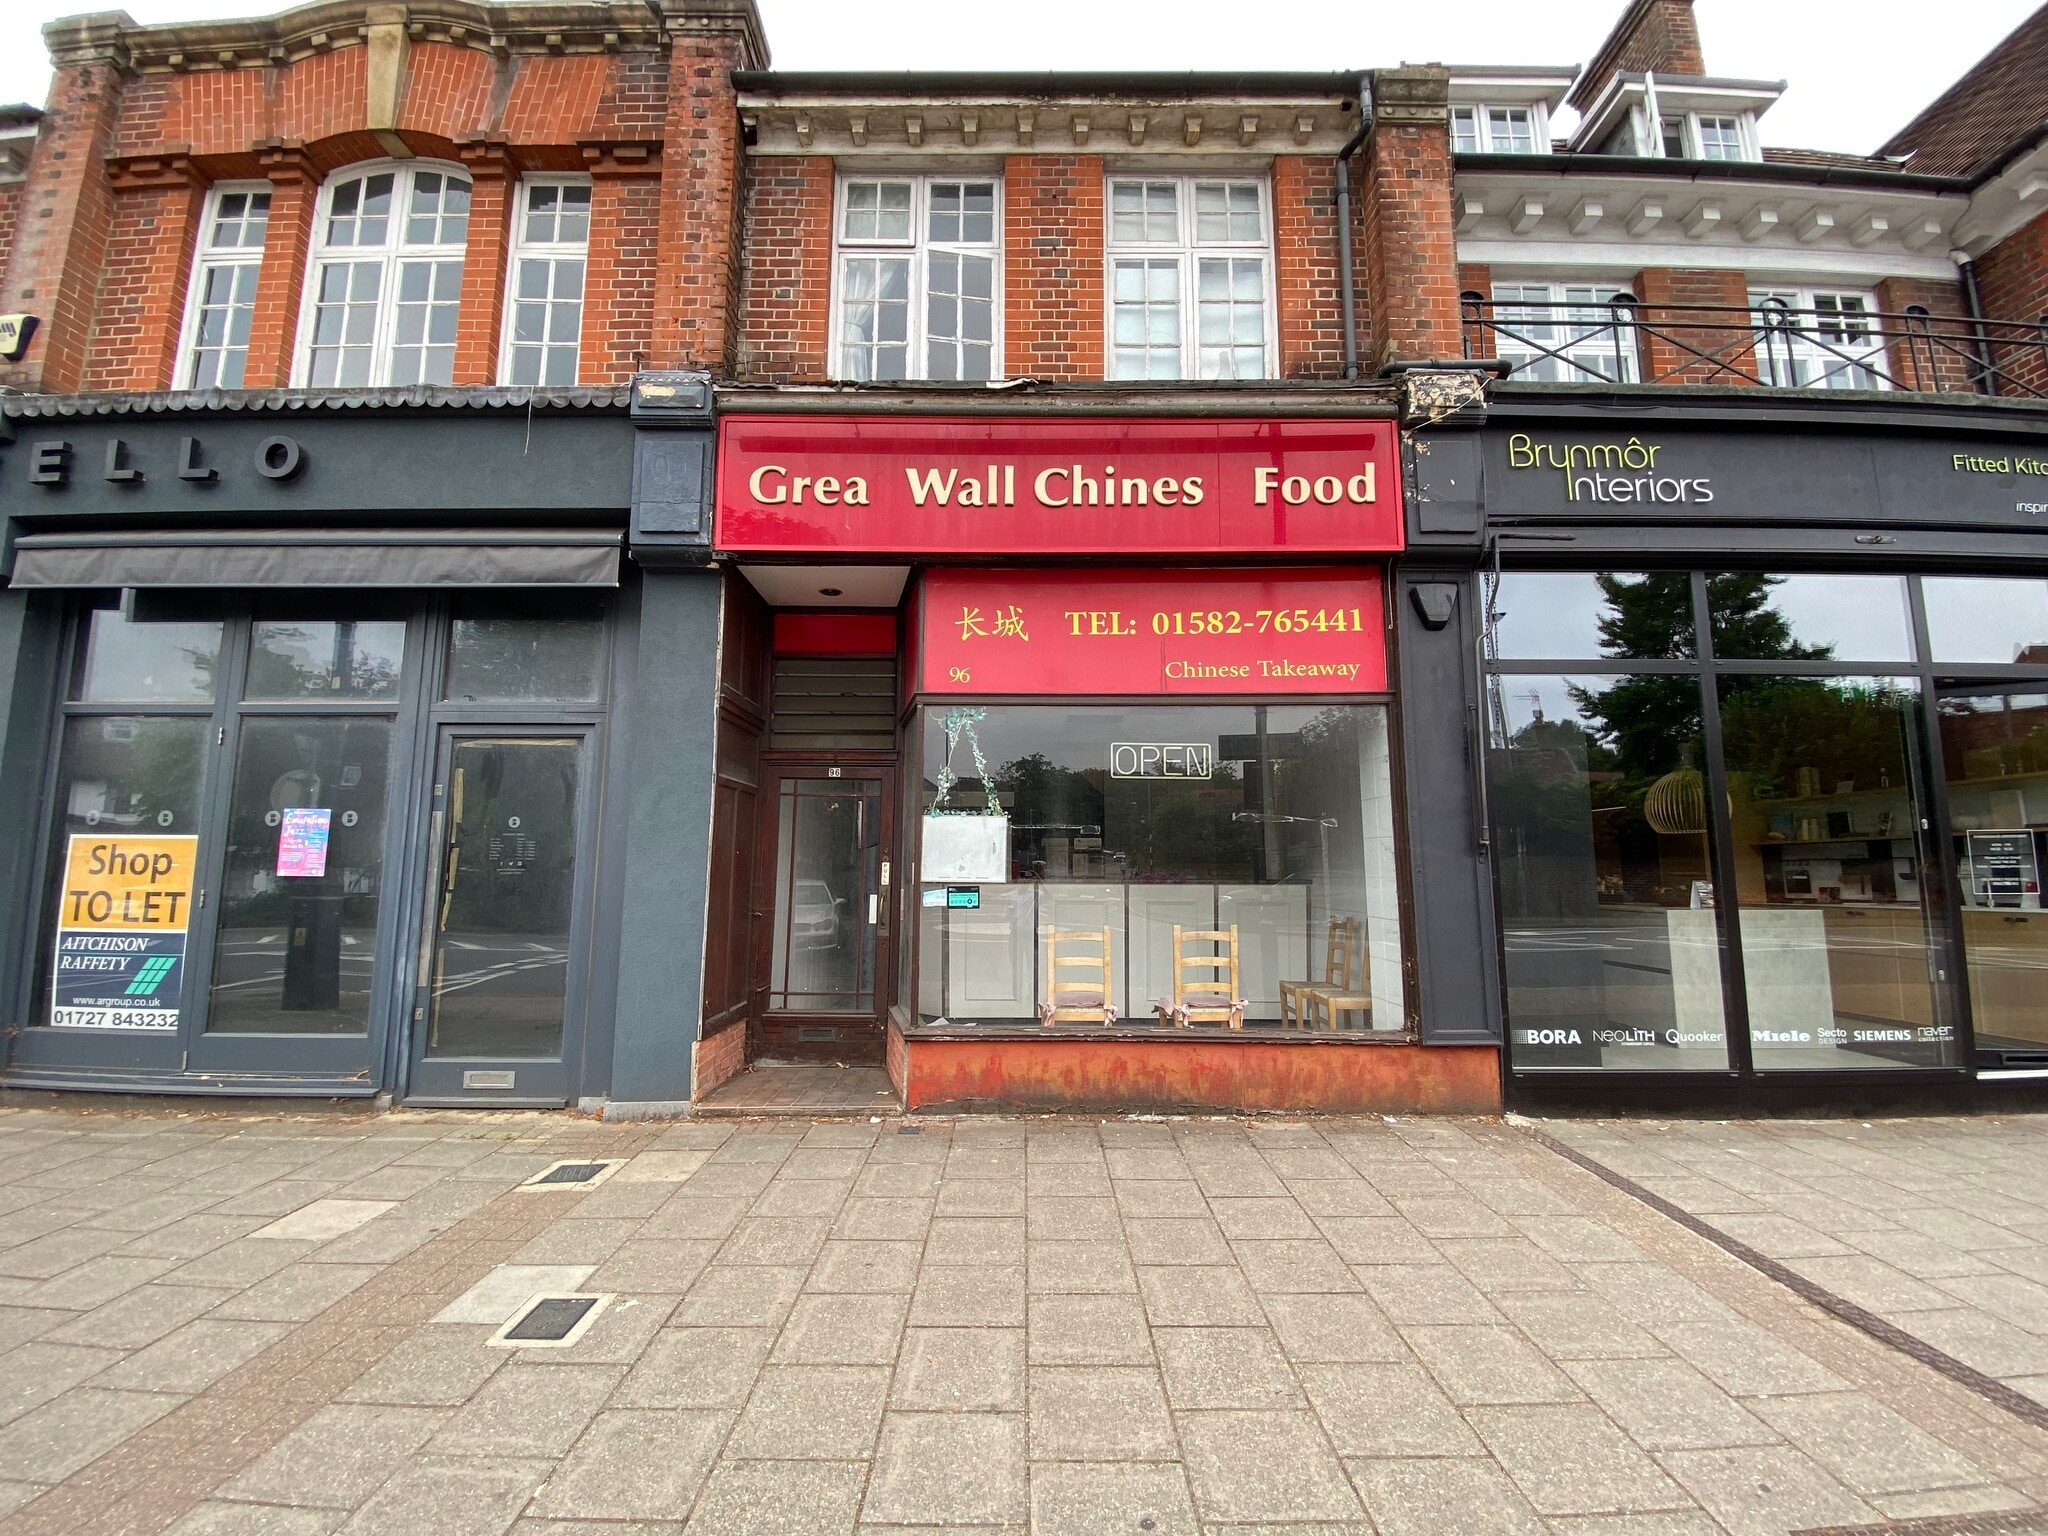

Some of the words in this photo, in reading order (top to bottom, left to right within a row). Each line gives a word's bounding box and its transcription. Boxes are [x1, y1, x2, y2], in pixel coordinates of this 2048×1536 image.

[1509, 434, 1661, 500] Brynmôr
[1953, 454, 2010, 473] Fitted
[749, 465, 870, 505] Grea
[905, 465, 1016, 507] Wall
[1034, 465, 1204, 506] Chines
[1254, 461, 1376, 504] Food
[954, 605, 1029, 643] 长城
[1065, 611, 1136, 635] TEL:
[1152, 608, 1364, 635] 01582-765441
[949, 667, 971, 684] 96
[1165, 661, 1250, 678] Chinese
[1257, 660, 1361, 681] Takeaway
[1116, 746, 1207, 776] OPEN
[829, 768, 840, 777] 96
[88, 844, 173, 883] Shop
[69, 890, 112, 922] TO
[122, 891, 186, 923] LET
[61, 936, 150, 951] AITCHISON
[59, 955, 132, 970] RAFFETY
[72, 997, 160, 1007] www.argroup.co.uk
[54, 1010, 107, 1024] 01727
[112, 1012, 179, 1027] 843232
[1527, 1029, 1582, 1045] BORA
[1665, 1028, 1723, 1045] Quooker
[1751, 1030, 1811, 1042] Miele
[1817, 1028, 1847, 1037] Secto
[1819, 1037, 1847, 1045] DESIGN
[1853, 1029, 1911, 1041] SIEMENS
